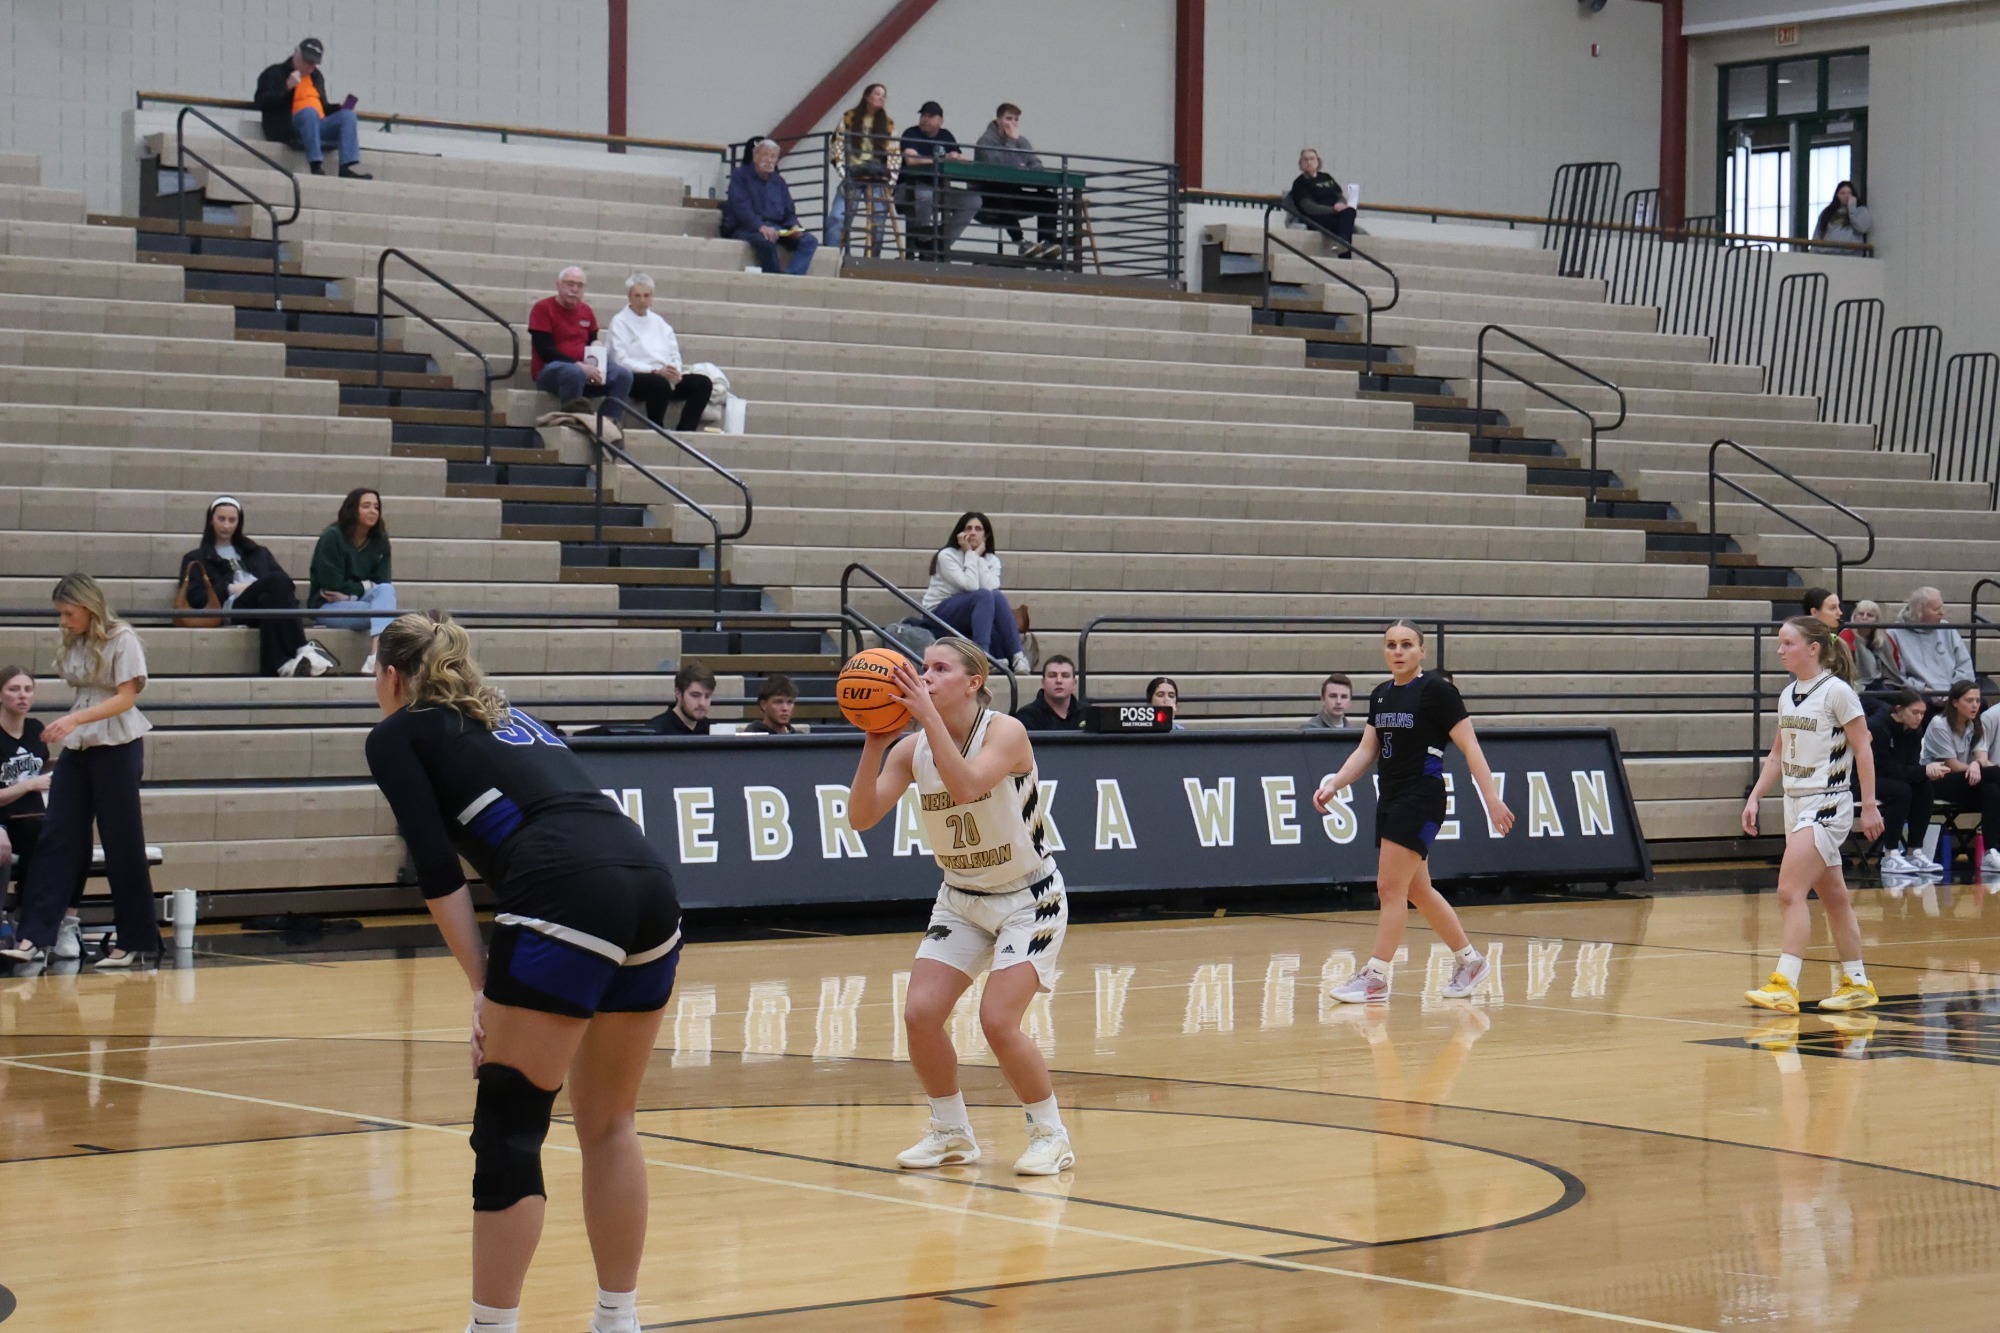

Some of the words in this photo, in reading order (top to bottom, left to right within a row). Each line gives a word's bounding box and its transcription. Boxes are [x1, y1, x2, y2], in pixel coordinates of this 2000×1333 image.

[841, 658, 889, 676] Wilson
[1120, 707, 1155, 721] POSS
[1381, 732, 1393, 759] 5
[945, 811, 981, 850] 20
[937, 843, 1012, 870] WESLEYAN
